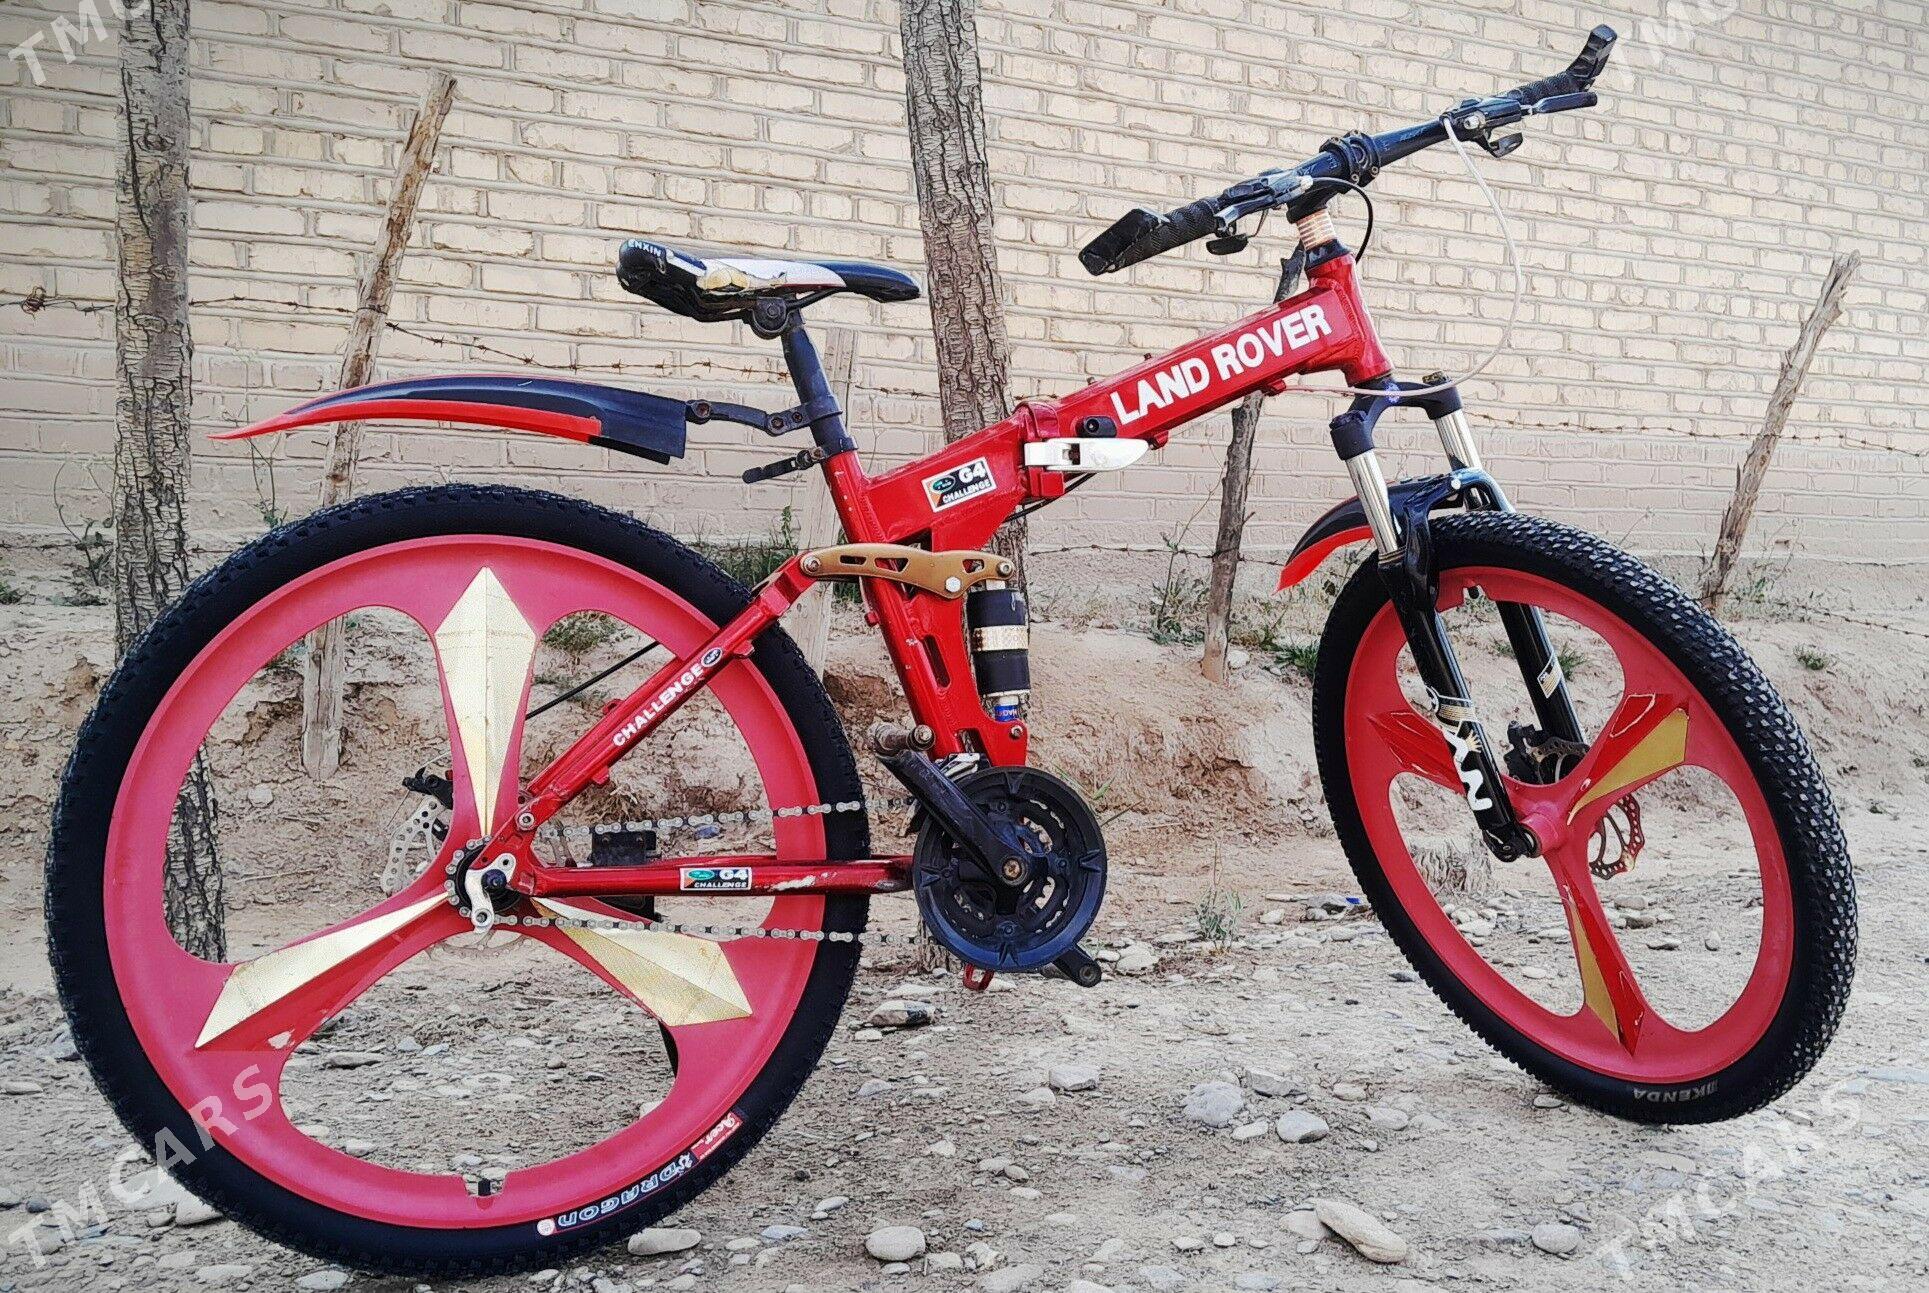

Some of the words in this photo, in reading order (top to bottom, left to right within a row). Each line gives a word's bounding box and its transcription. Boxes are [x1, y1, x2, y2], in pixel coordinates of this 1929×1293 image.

[1110, 358, 1210, 425] LAND
[1211, 304, 1332, 381] ROVER
[942, 479, 991, 503] CHALLENGE
[958, 462, 986, 483] G4
[613, 662, 704, 746] CHALLENGE
[1633, 1085, 1706, 1102] KENDA
[558, 1155, 678, 1227] DRAGON
